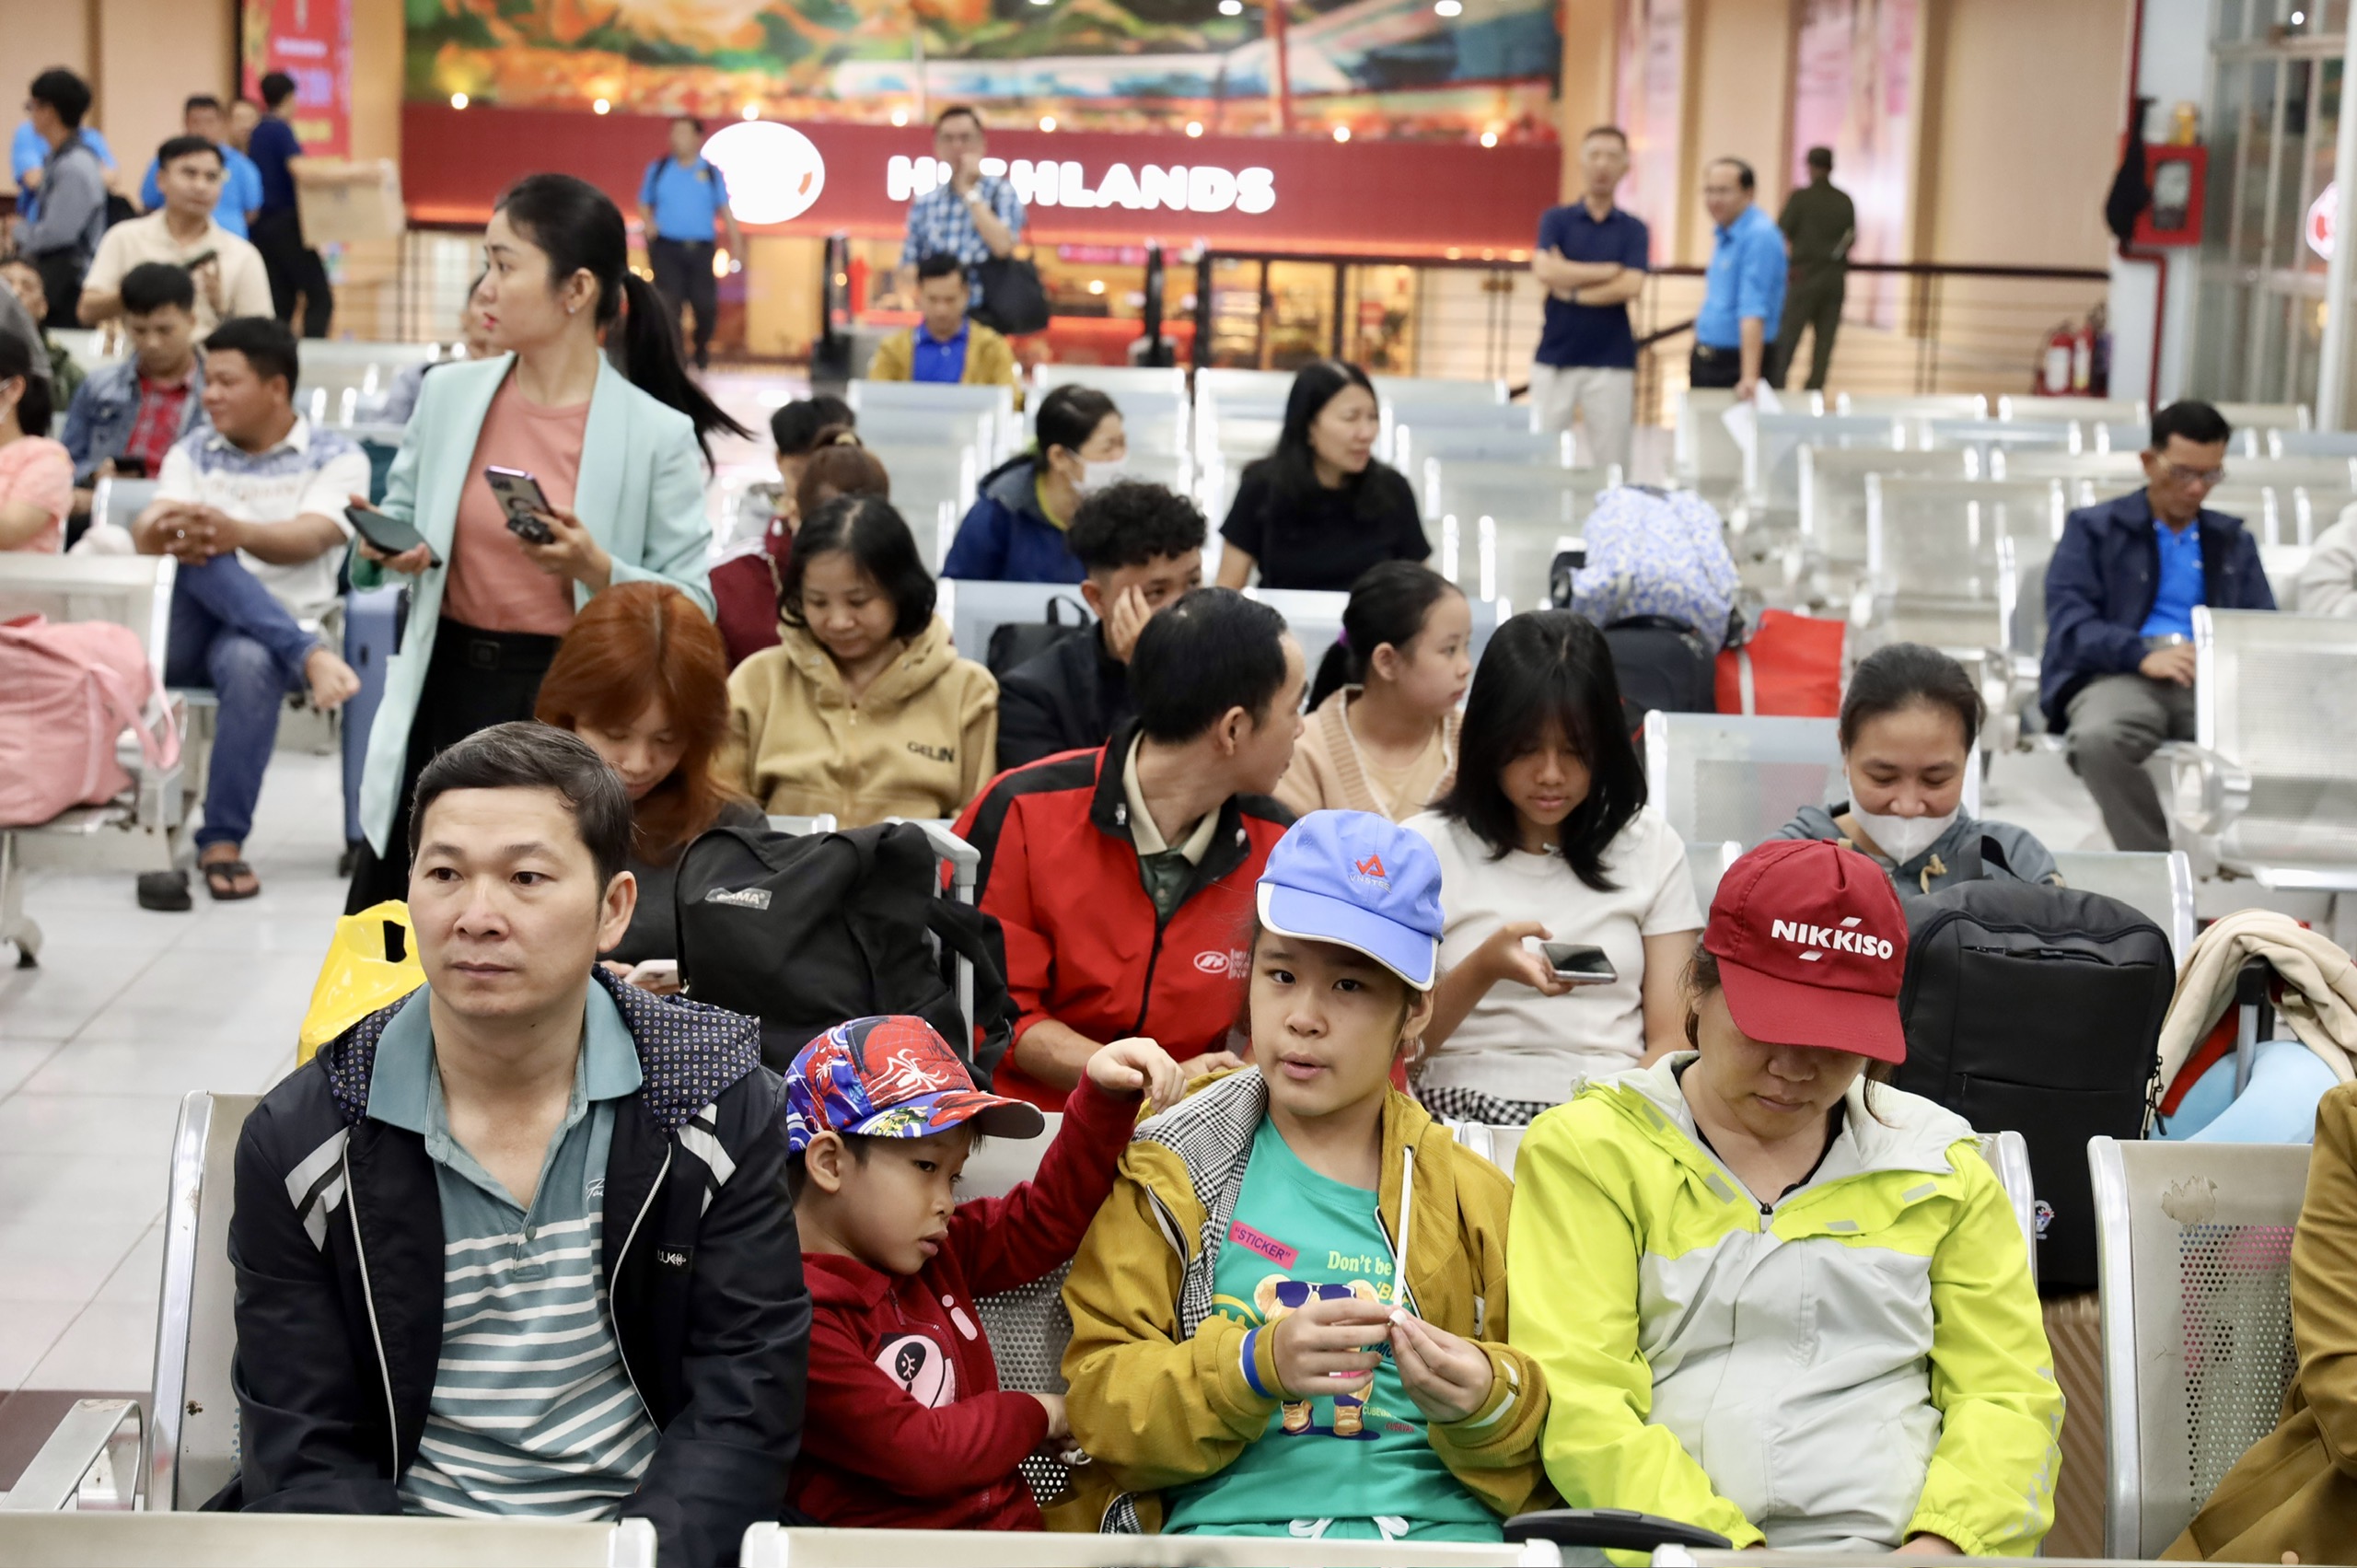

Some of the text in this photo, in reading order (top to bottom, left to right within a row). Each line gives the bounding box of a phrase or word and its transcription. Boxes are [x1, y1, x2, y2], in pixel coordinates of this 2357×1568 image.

[888, 155, 1276, 214] HHLANDS
[1771, 919, 1894, 959] NIKKISO
[1375, 1257, 1392, 1276] be
